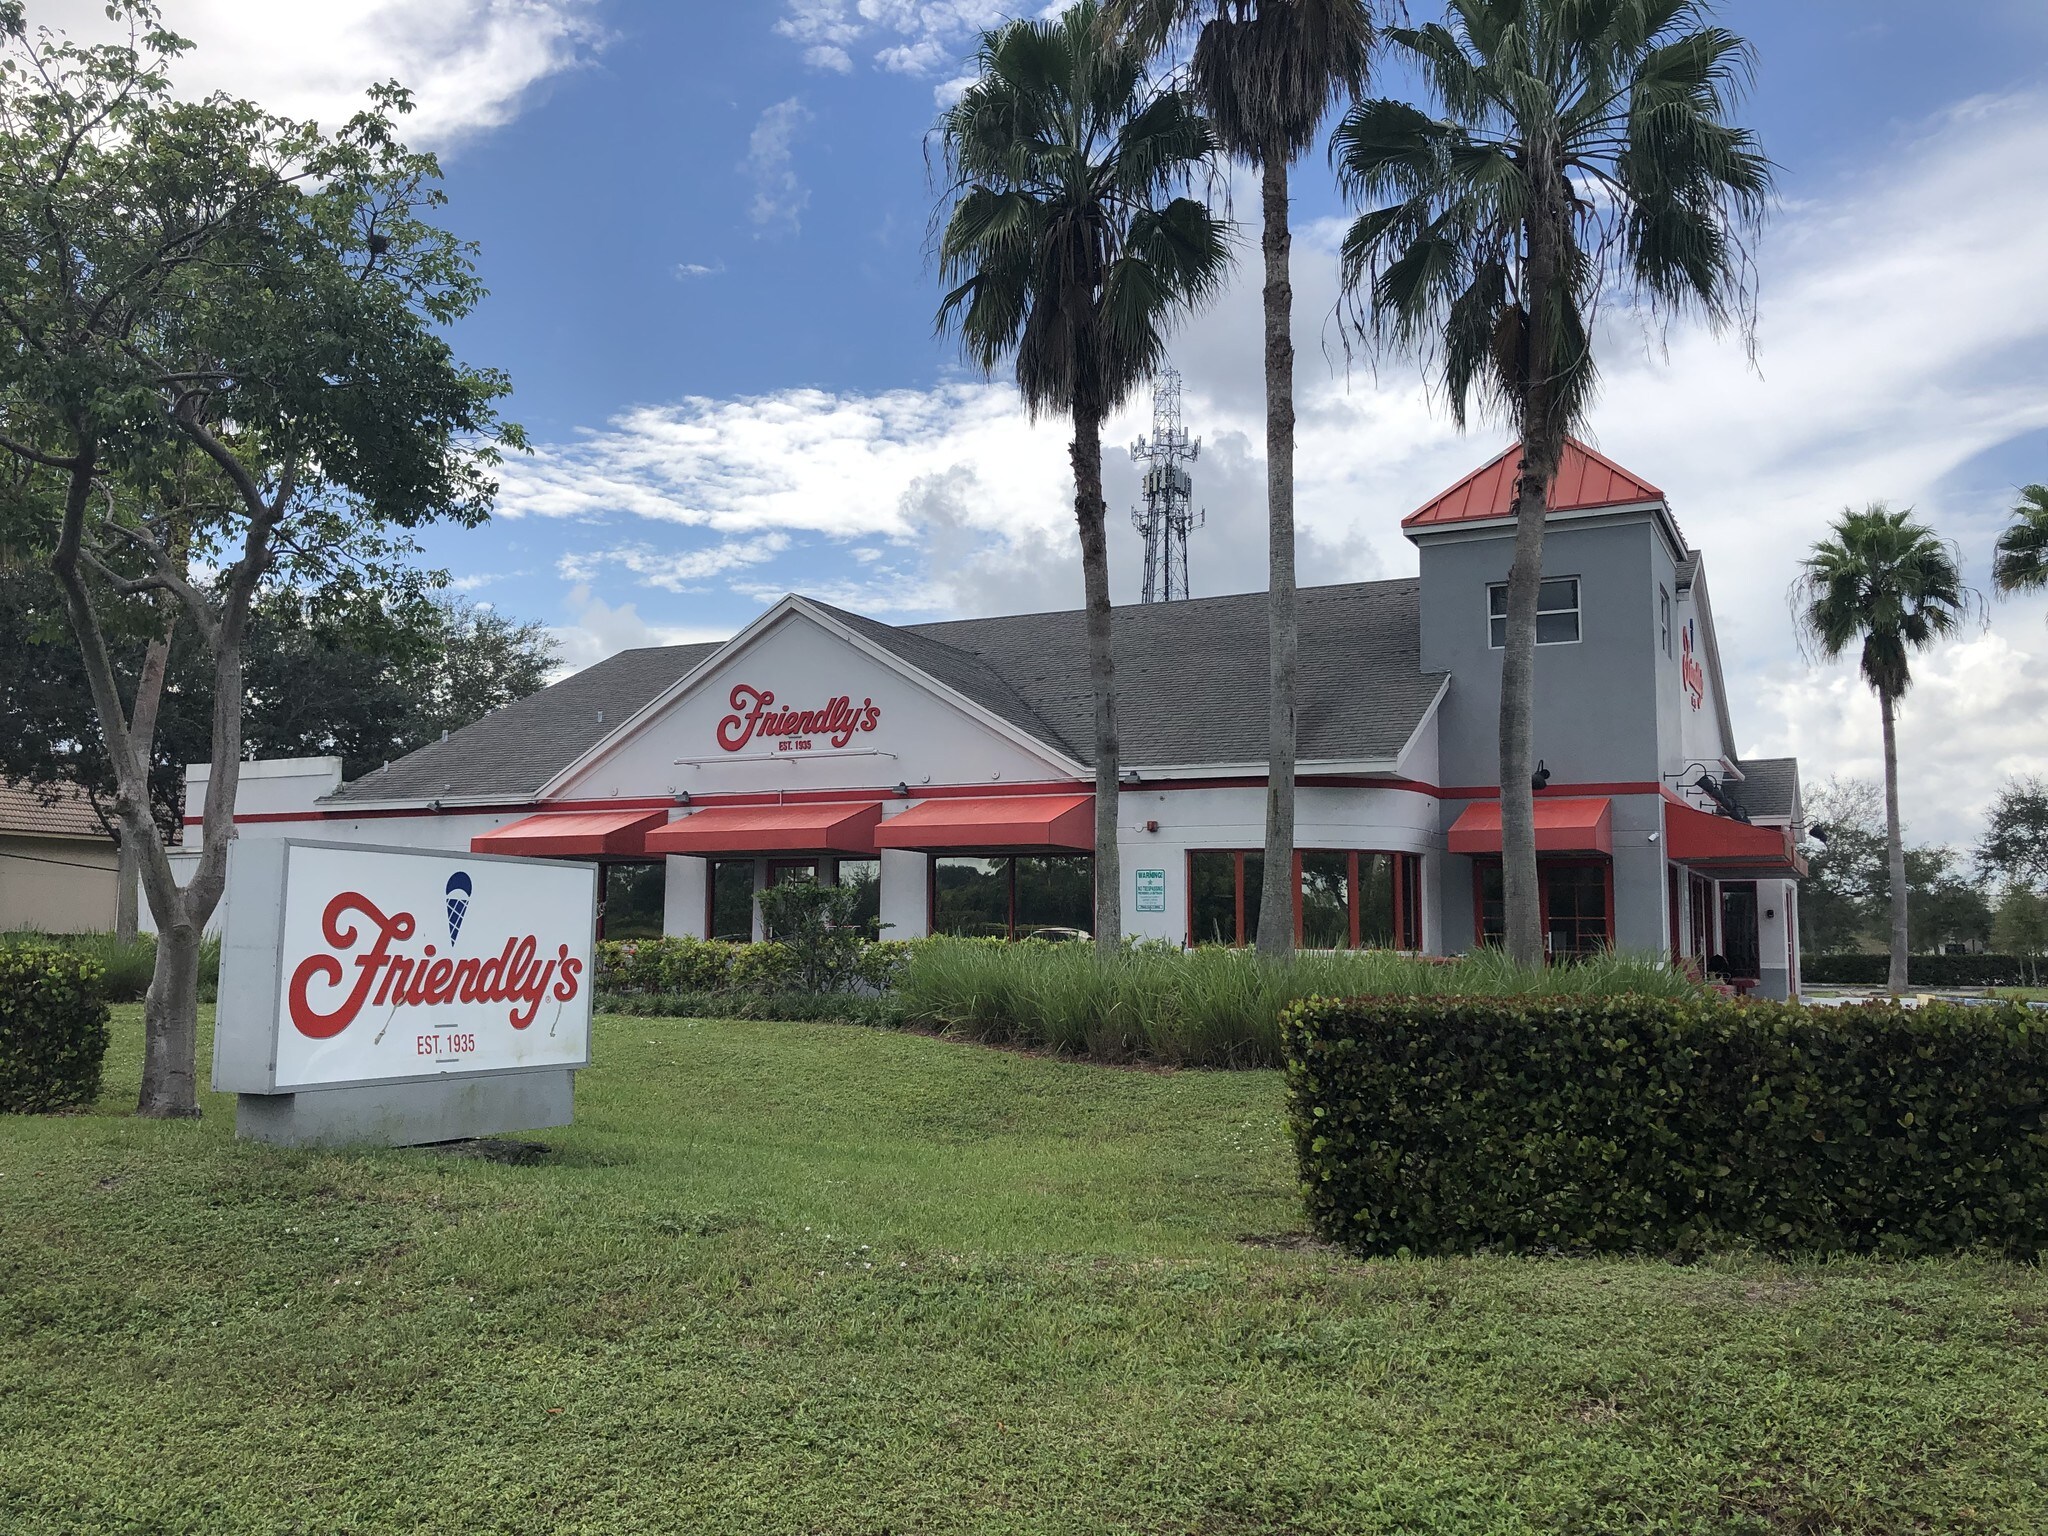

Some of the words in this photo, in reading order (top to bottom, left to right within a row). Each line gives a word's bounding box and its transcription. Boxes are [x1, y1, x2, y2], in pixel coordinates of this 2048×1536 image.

[716, 684, 880, 751] Friendly's
[778, 741, 793, 752] EST.
[795, 740, 812, 750] 1935
[289, 892, 583, 1039] Friendly's
[417, 1034, 442, 1055] EST.
[446, 1033, 475, 1053] 1935
